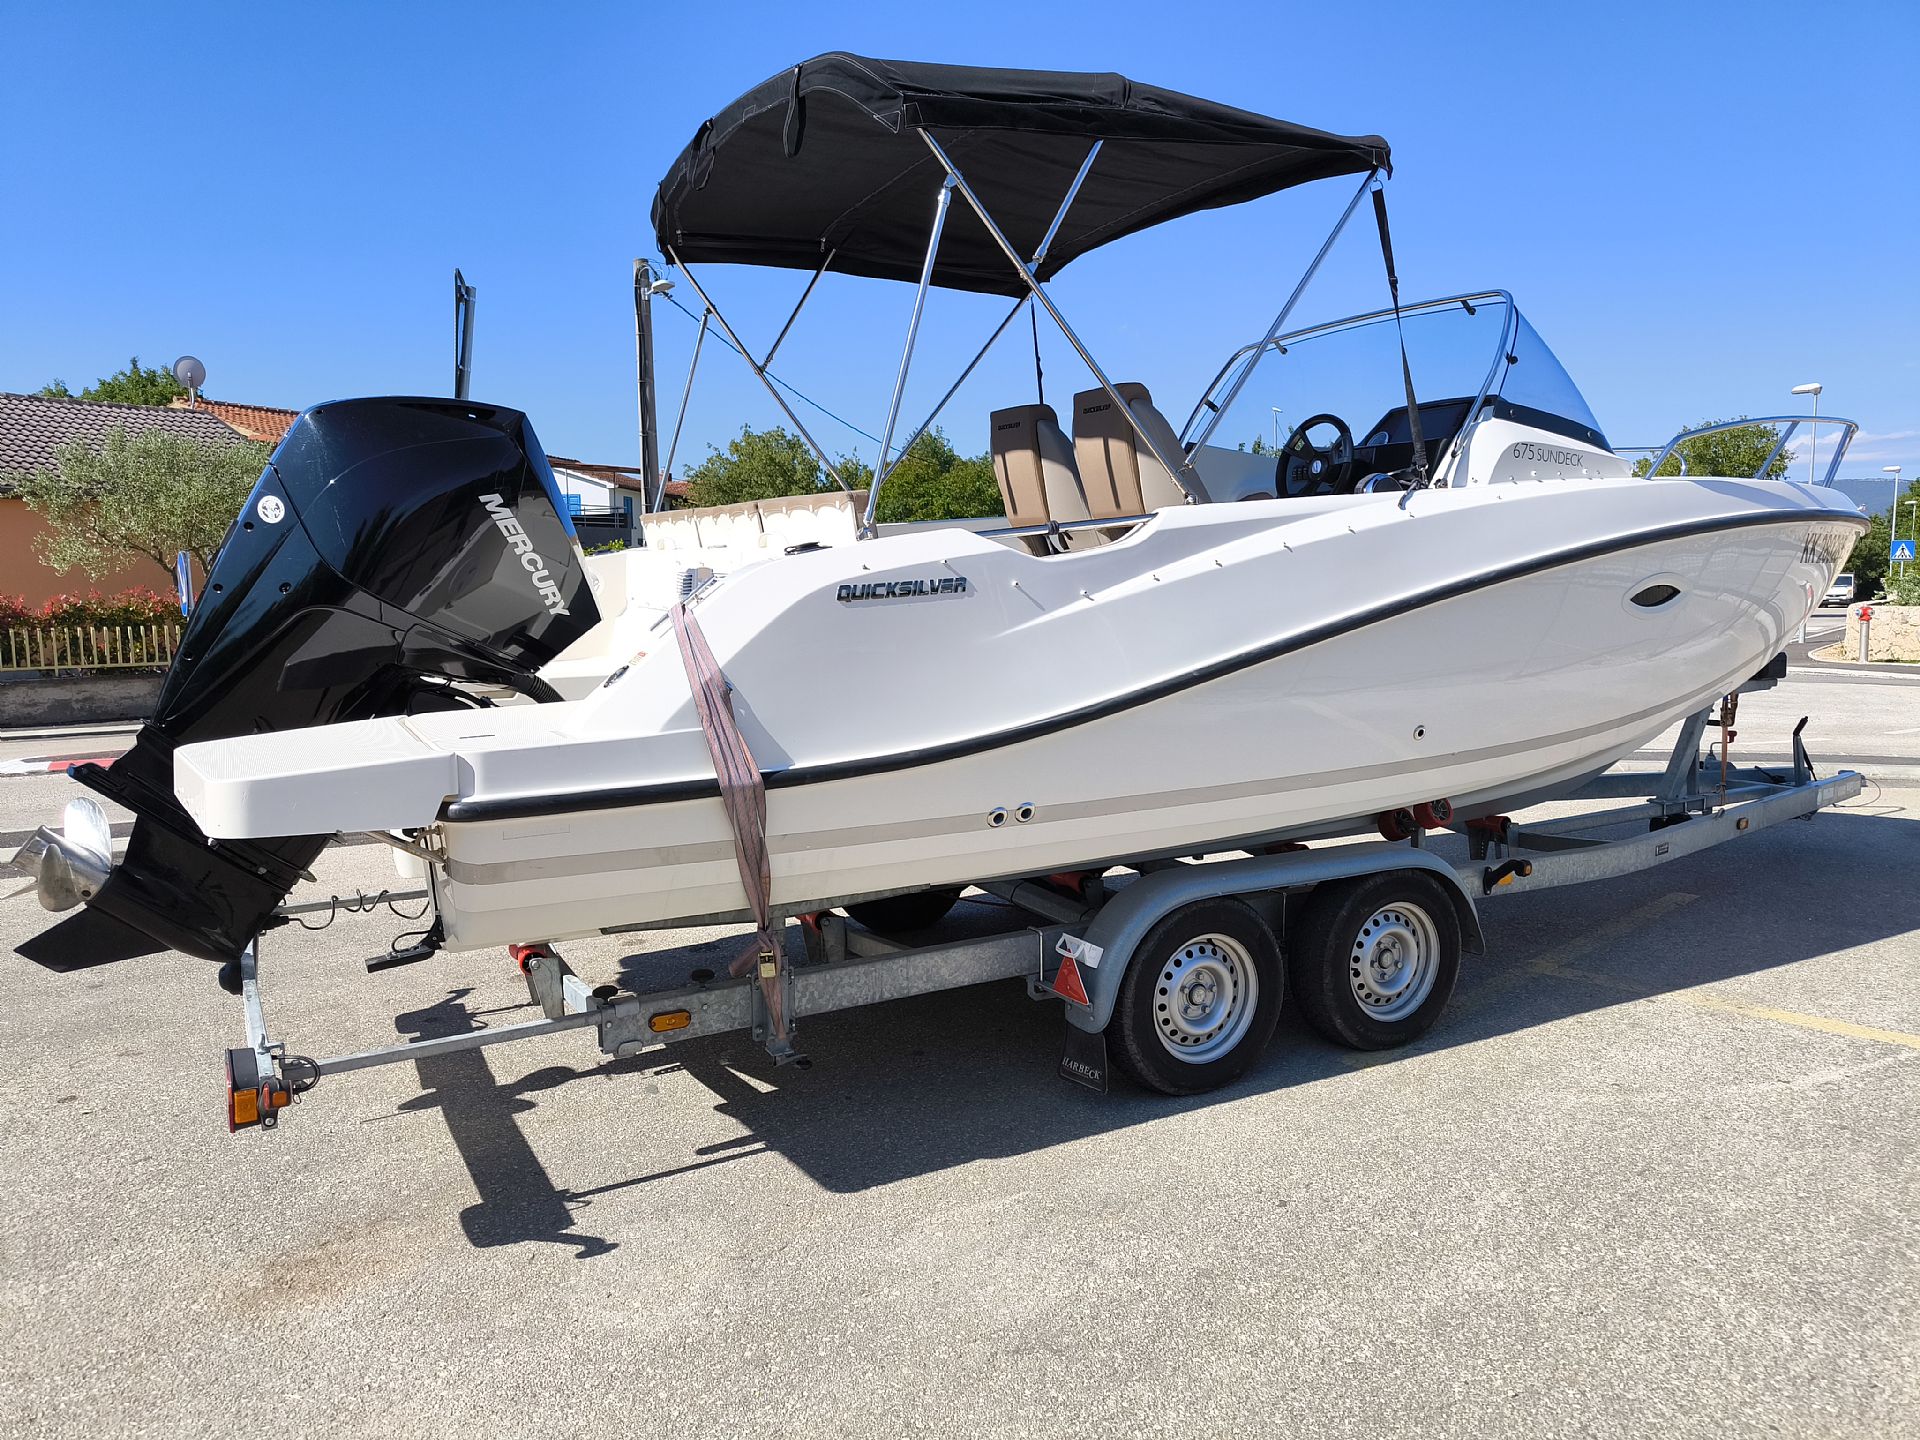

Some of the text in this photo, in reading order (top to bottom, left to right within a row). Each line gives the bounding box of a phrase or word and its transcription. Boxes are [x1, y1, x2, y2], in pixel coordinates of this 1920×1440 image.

[1513, 442, 1584, 467] 675 SUNDECK
[478, 493, 571, 616] MERCURY
[836, 576, 967, 602] QUICKSILVER
[1062, 1056, 1101, 1080] HARBECK
